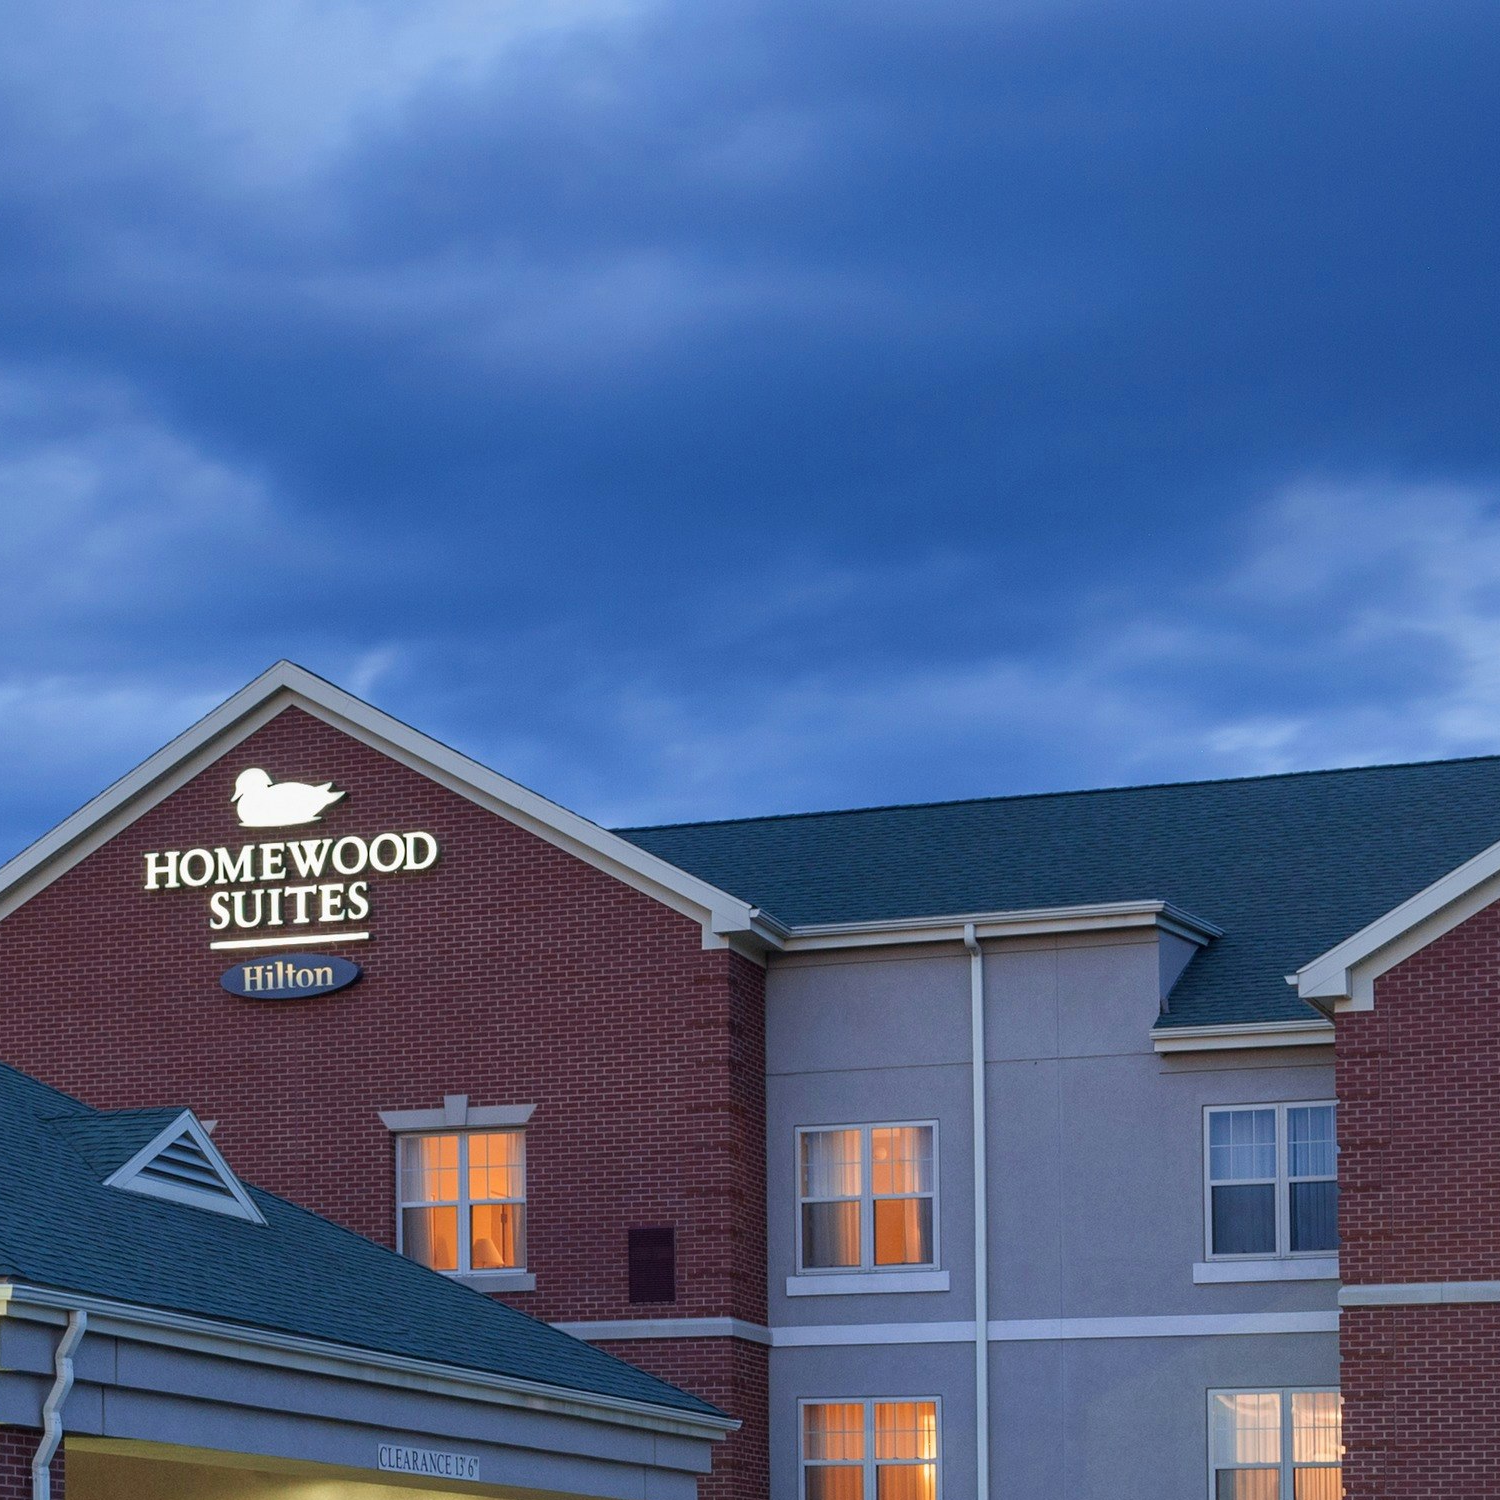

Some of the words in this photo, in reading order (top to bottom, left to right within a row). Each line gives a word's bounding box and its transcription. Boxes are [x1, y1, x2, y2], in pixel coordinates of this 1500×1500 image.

[144, 831, 438, 889] HOMEWOOD
[209, 881, 369, 930] SUITES
[242, 961, 334, 992] Hilton
[379, 1446, 452, 1475] CLEARANCE
